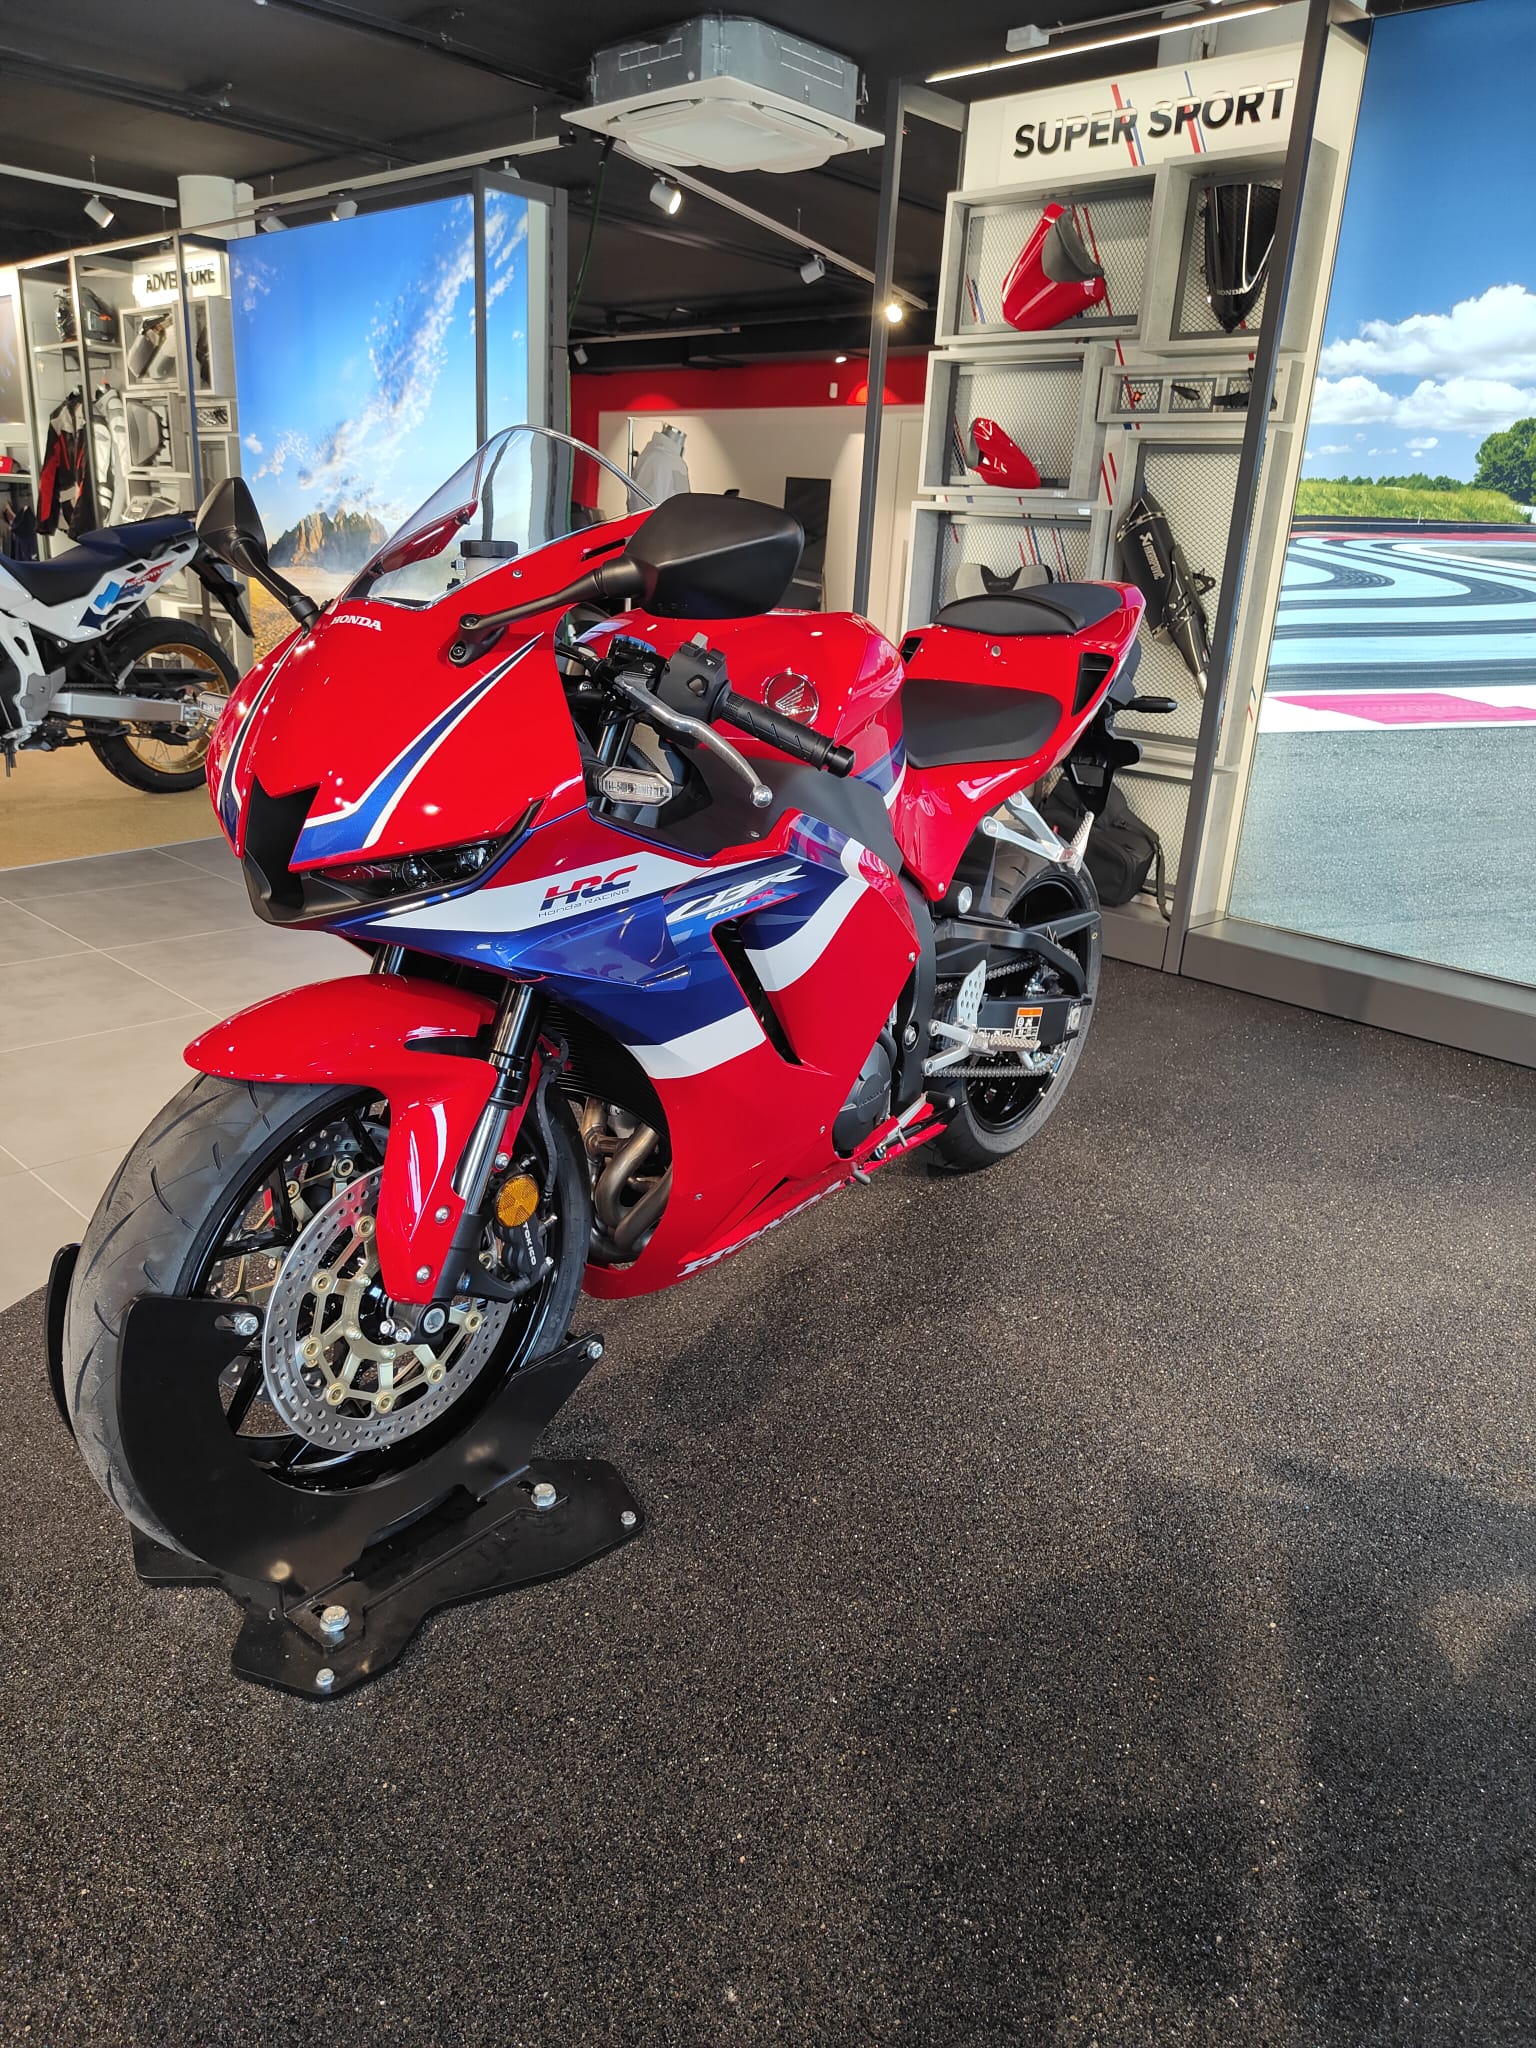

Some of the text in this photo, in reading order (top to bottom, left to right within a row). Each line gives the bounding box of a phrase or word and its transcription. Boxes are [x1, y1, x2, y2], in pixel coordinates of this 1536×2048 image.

[1013, 79, 1295, 158] SUPER SPORT
[146, 263, 216, 293] ADVETURE
[330, 614, 382, 631] HONDA
[540, 864, 639, 911] HRC
[584, 887, 630, 905] RACING
[665, 864, 807, 924] CBR
[705, 888, 776, 920] 600RR
[522, 1221, 537, 1266] TOKICO
